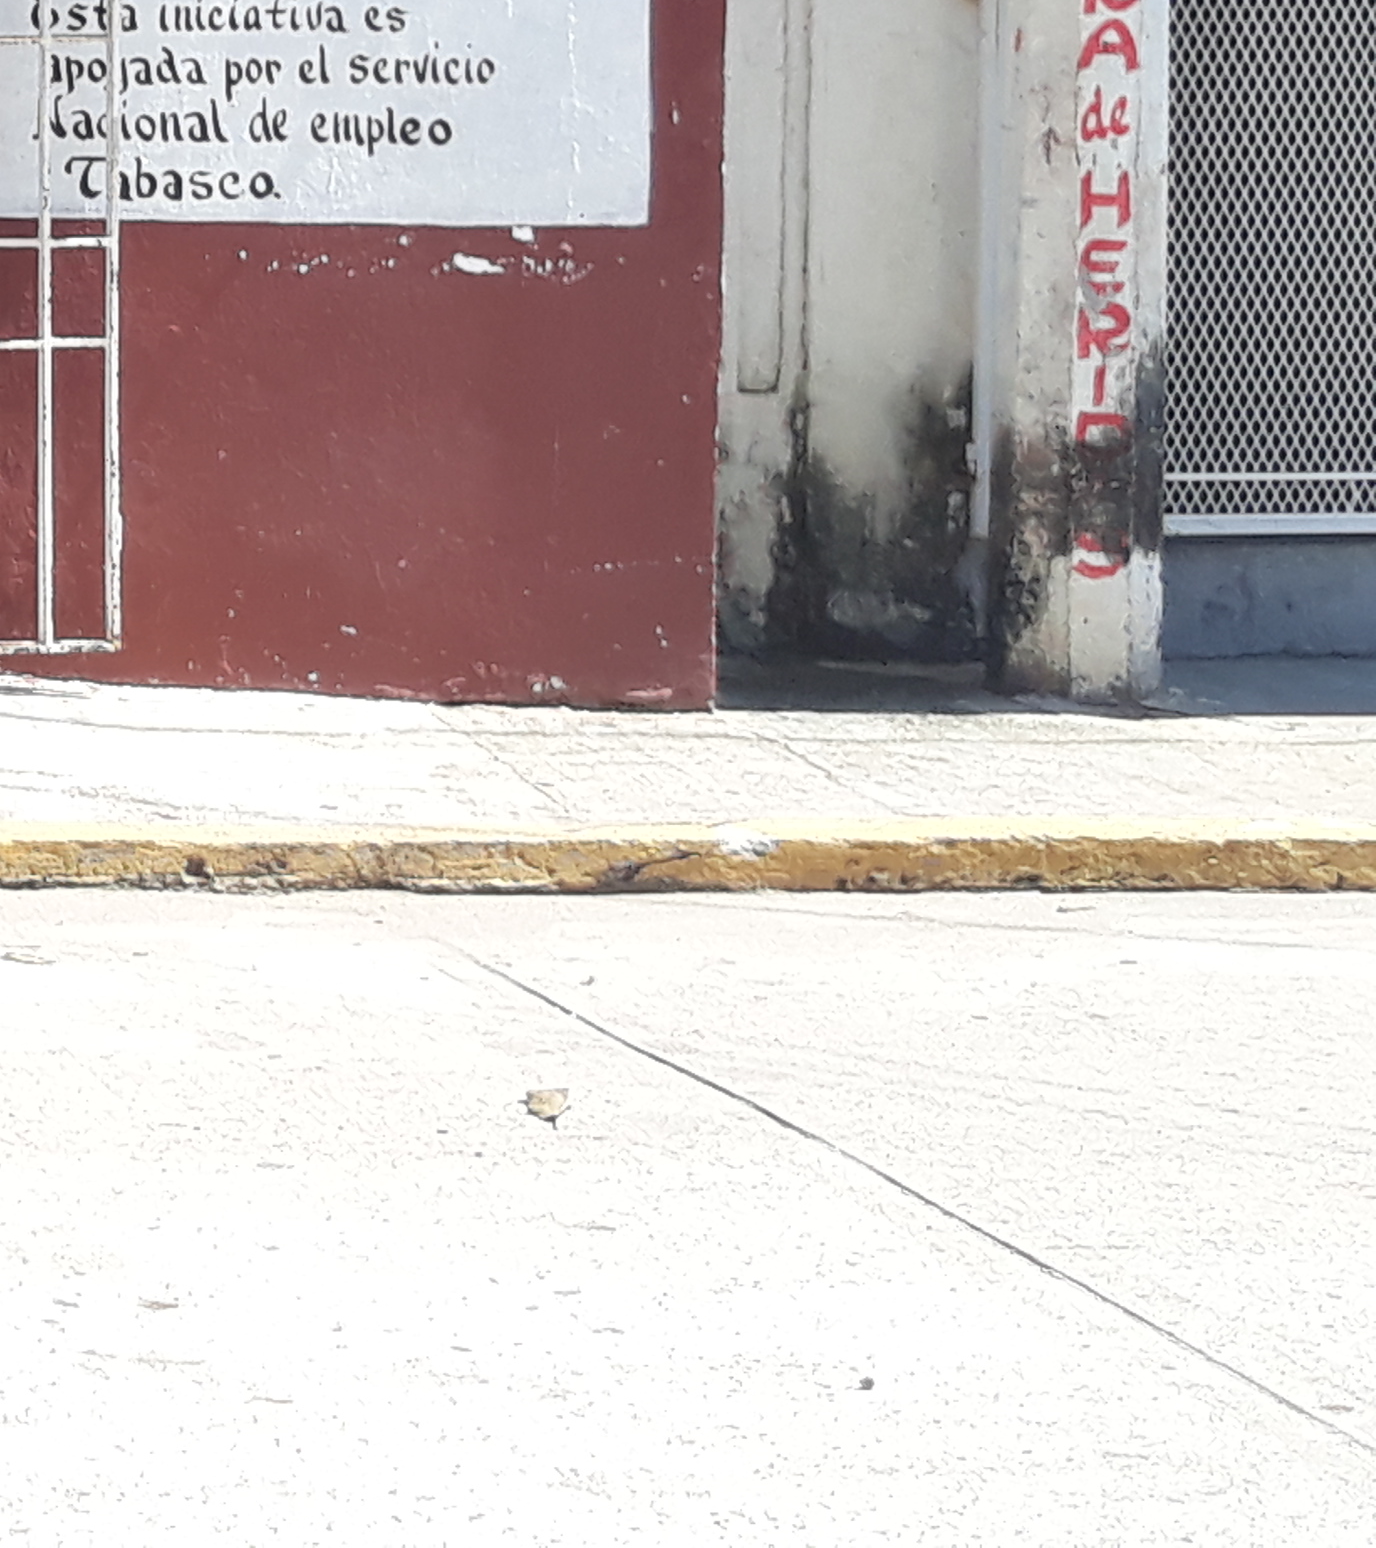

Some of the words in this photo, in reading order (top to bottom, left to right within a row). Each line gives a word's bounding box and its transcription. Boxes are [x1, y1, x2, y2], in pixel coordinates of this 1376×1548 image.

[364, 5, 410, 33] es
[224, 56, 282, 102] por
[298, 43, 331, 85] el
[248, 96, 289, 144] de
[309, 106, 454, 158] empleo
[1080, 84, 1132, 142] de
